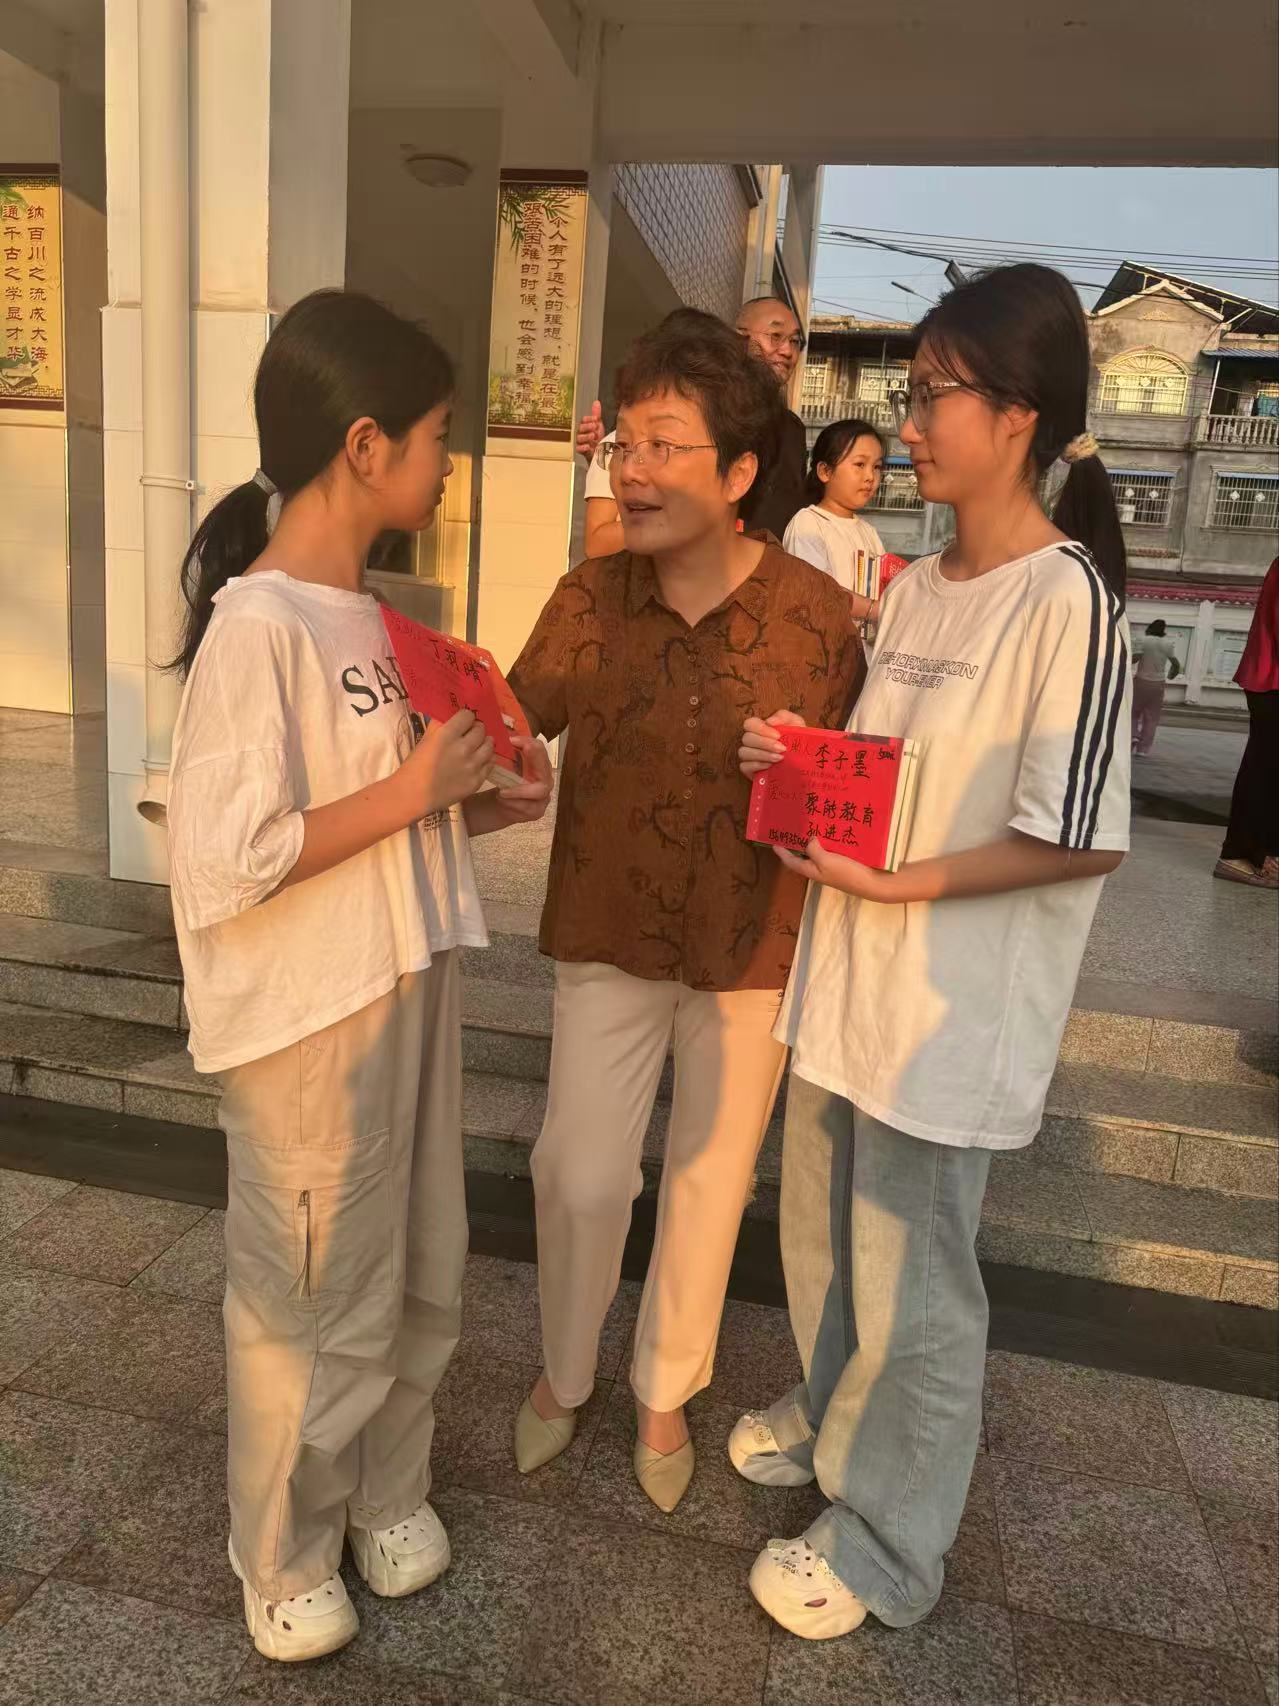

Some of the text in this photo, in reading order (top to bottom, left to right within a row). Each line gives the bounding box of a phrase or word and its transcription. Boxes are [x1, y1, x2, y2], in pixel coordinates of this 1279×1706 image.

[341, 656, 409, 717] SA
[815, 743, 871, 779] 李子墨
[804, 791, 874, 828] 聚能教育
